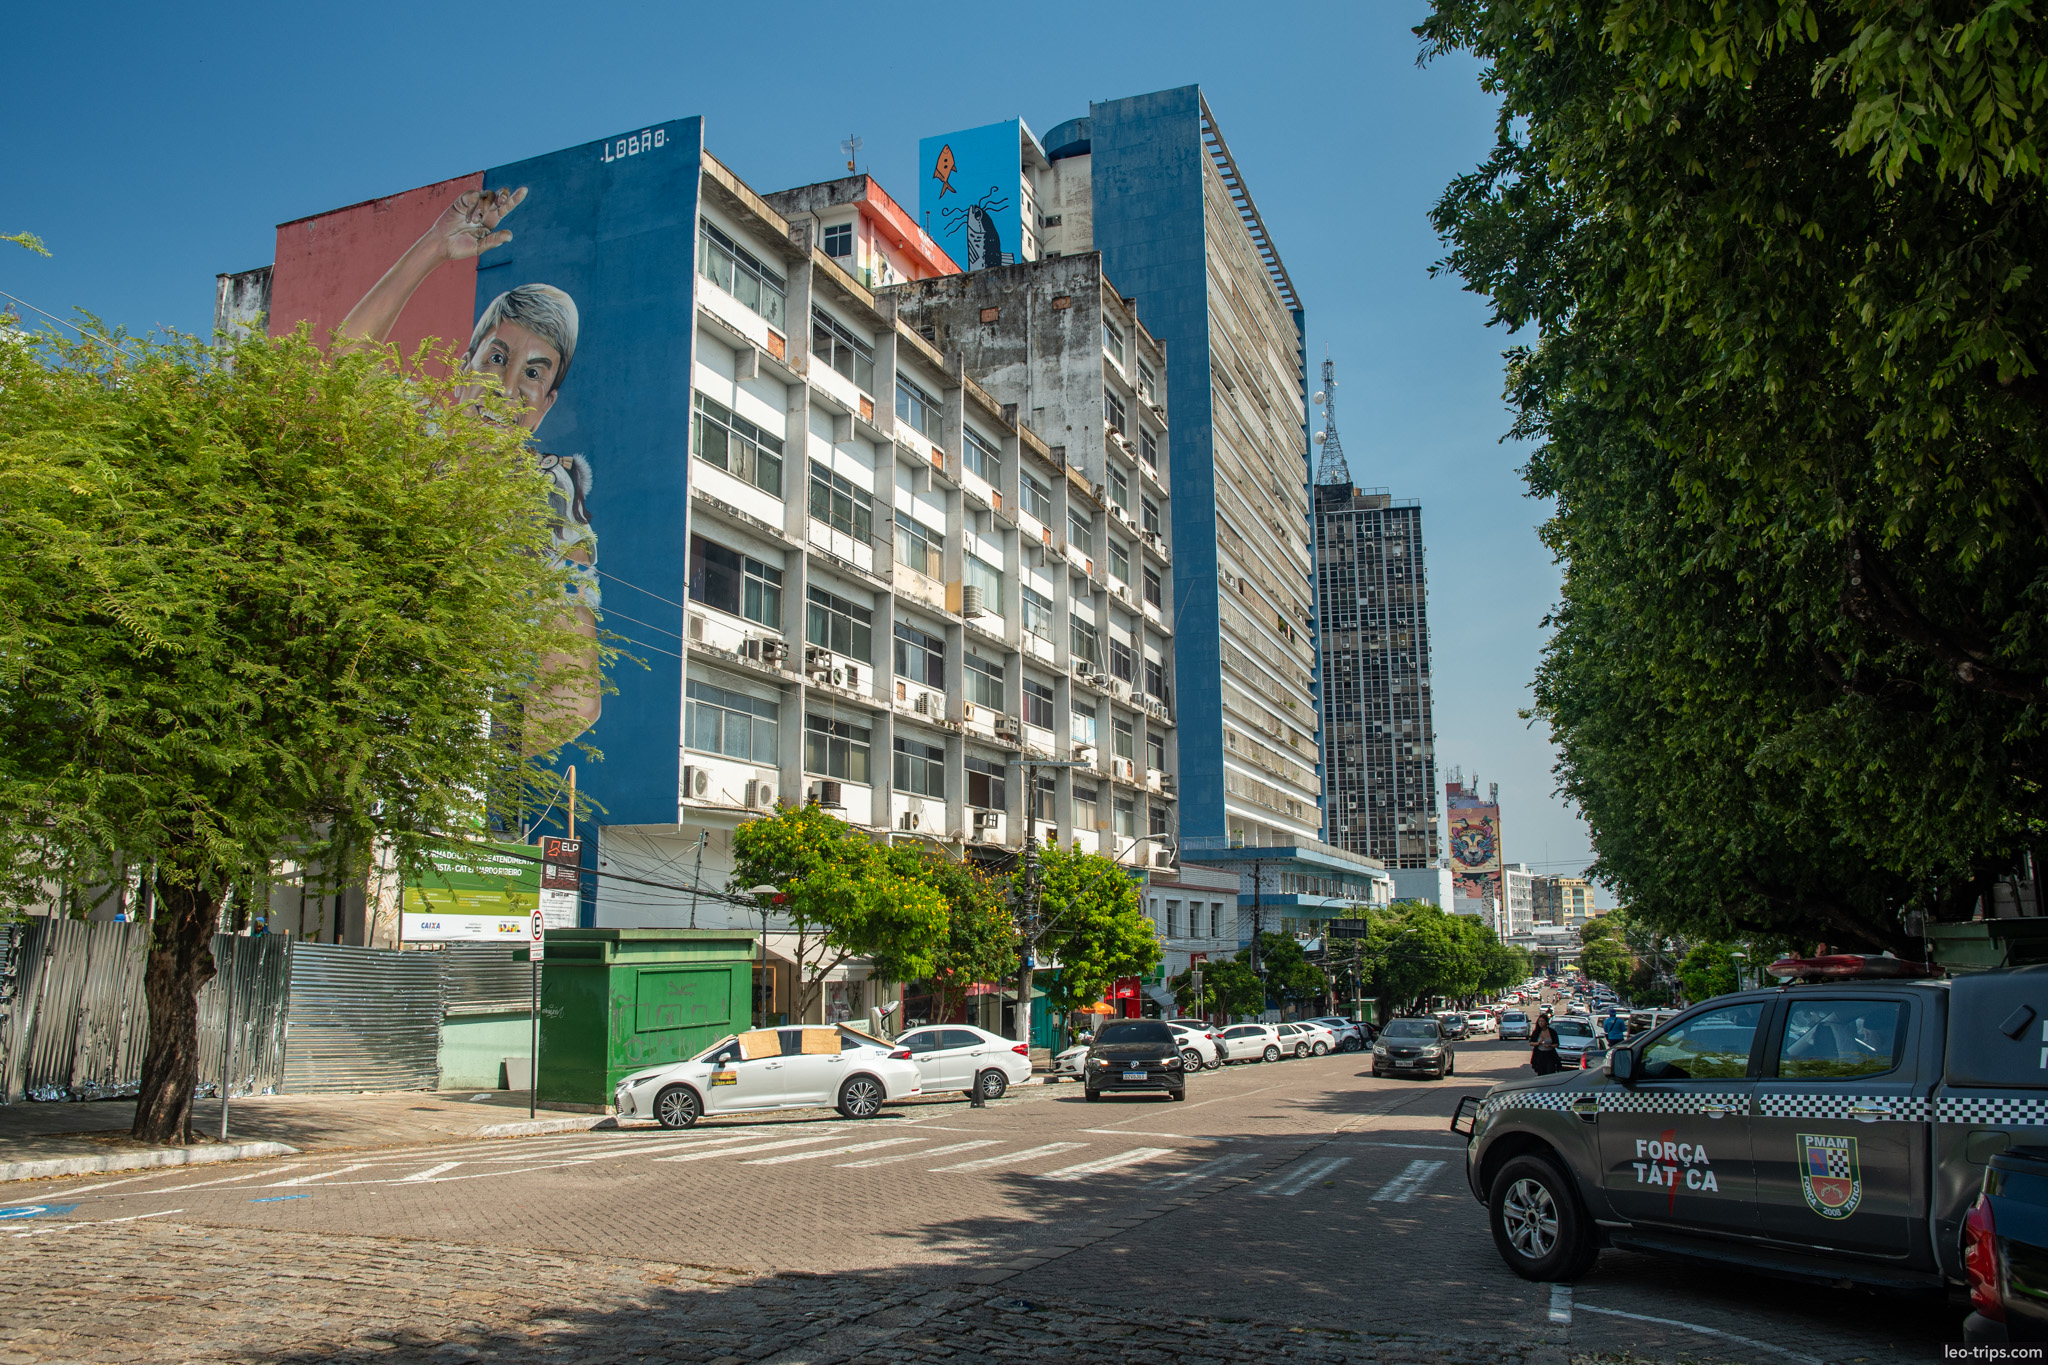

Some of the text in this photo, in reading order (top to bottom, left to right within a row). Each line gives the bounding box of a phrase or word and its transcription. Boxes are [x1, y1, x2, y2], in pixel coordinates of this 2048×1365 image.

[561, 842, 579, 853] ELP
[455, 864, 469, 873] CAT
[421, 922, 441, 930] CAIXA
[535, 917, 541, 935] E
[1805, 1136, 1848, 1149] PMAM
[1636, 1139, 1710, 1168] FORÇA
[1844, 1180, 1860, 1211] TÁTICA
[1822, 1206, 1842, 1217] 2008
